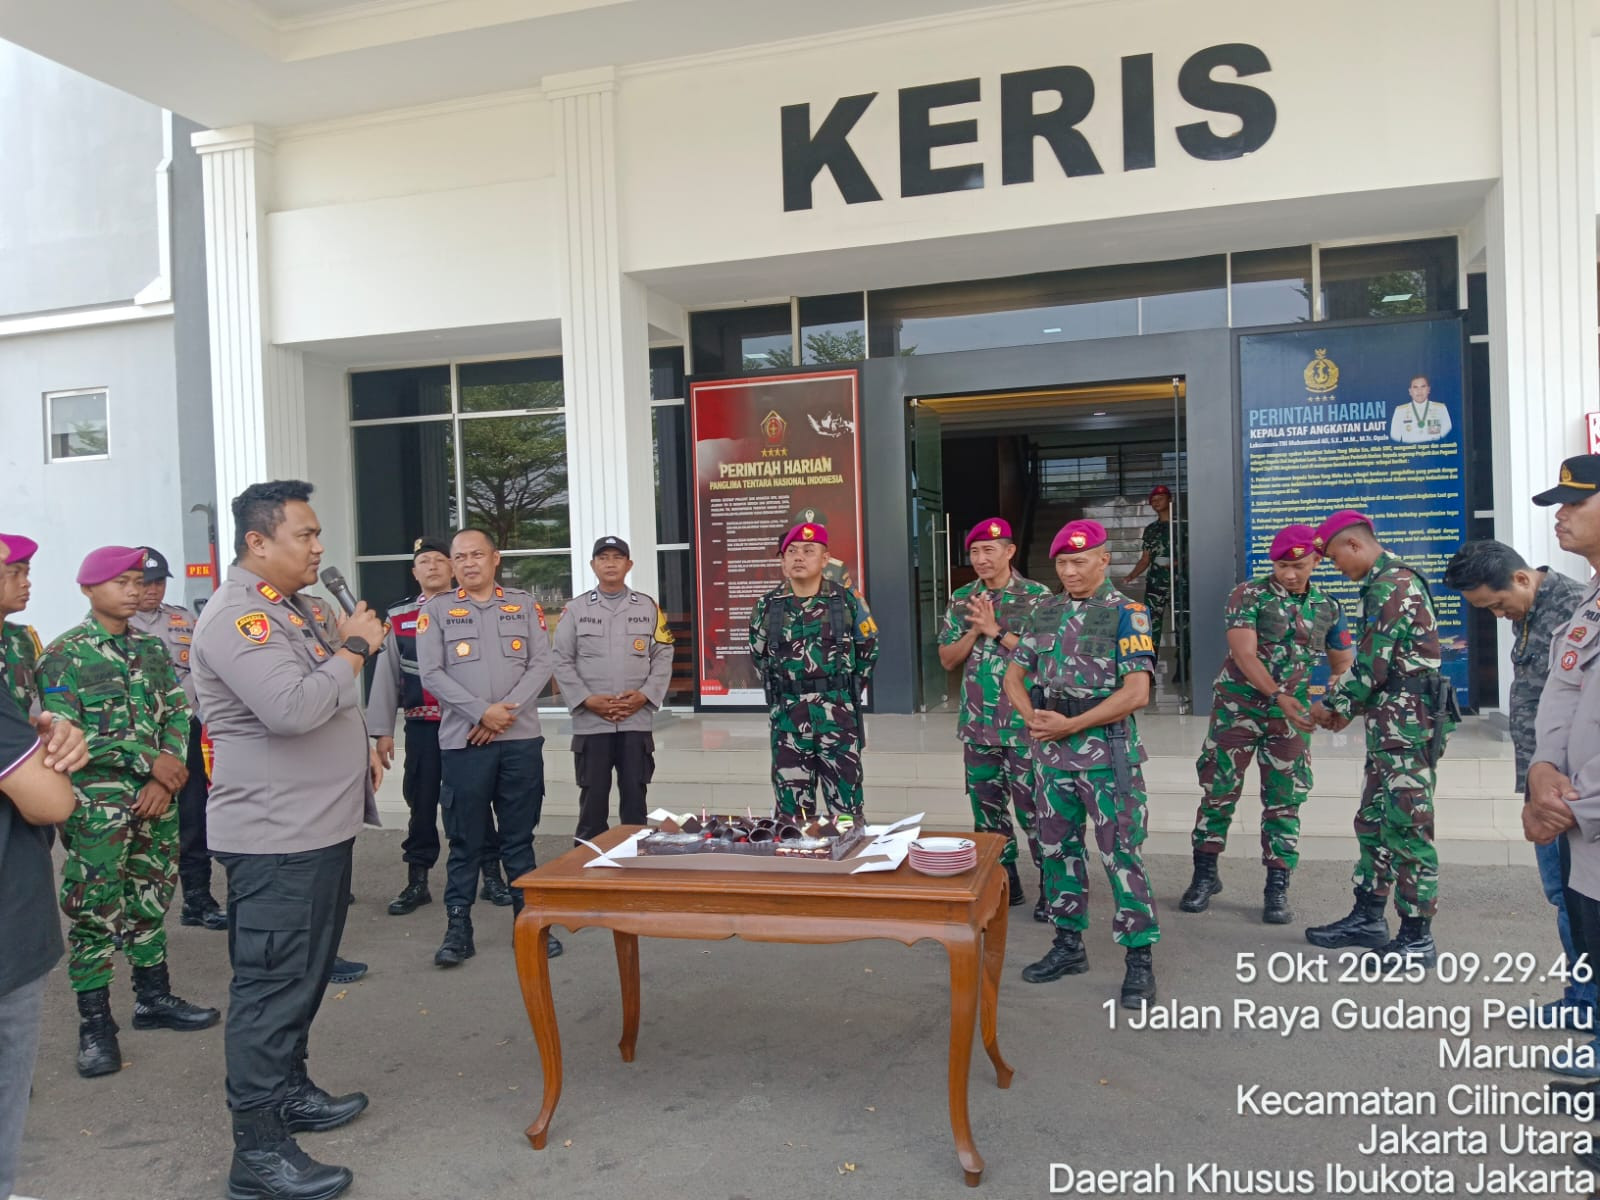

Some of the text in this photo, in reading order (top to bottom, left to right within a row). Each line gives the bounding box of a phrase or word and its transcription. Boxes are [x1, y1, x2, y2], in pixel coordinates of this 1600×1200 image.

[781, 43, 1277, 212] KERIS
[1249, 401, 1387, 427] PERINTAH HARIAN
[1250, 421, 1387, 439] KEPALA STAF ANGKATAN LAUT
[720, 457, 832, 478] PERINTAH HARIAN
[709, 474, 843, 491] PANGLIMA TENTARA NASIONAL INDONESIA
